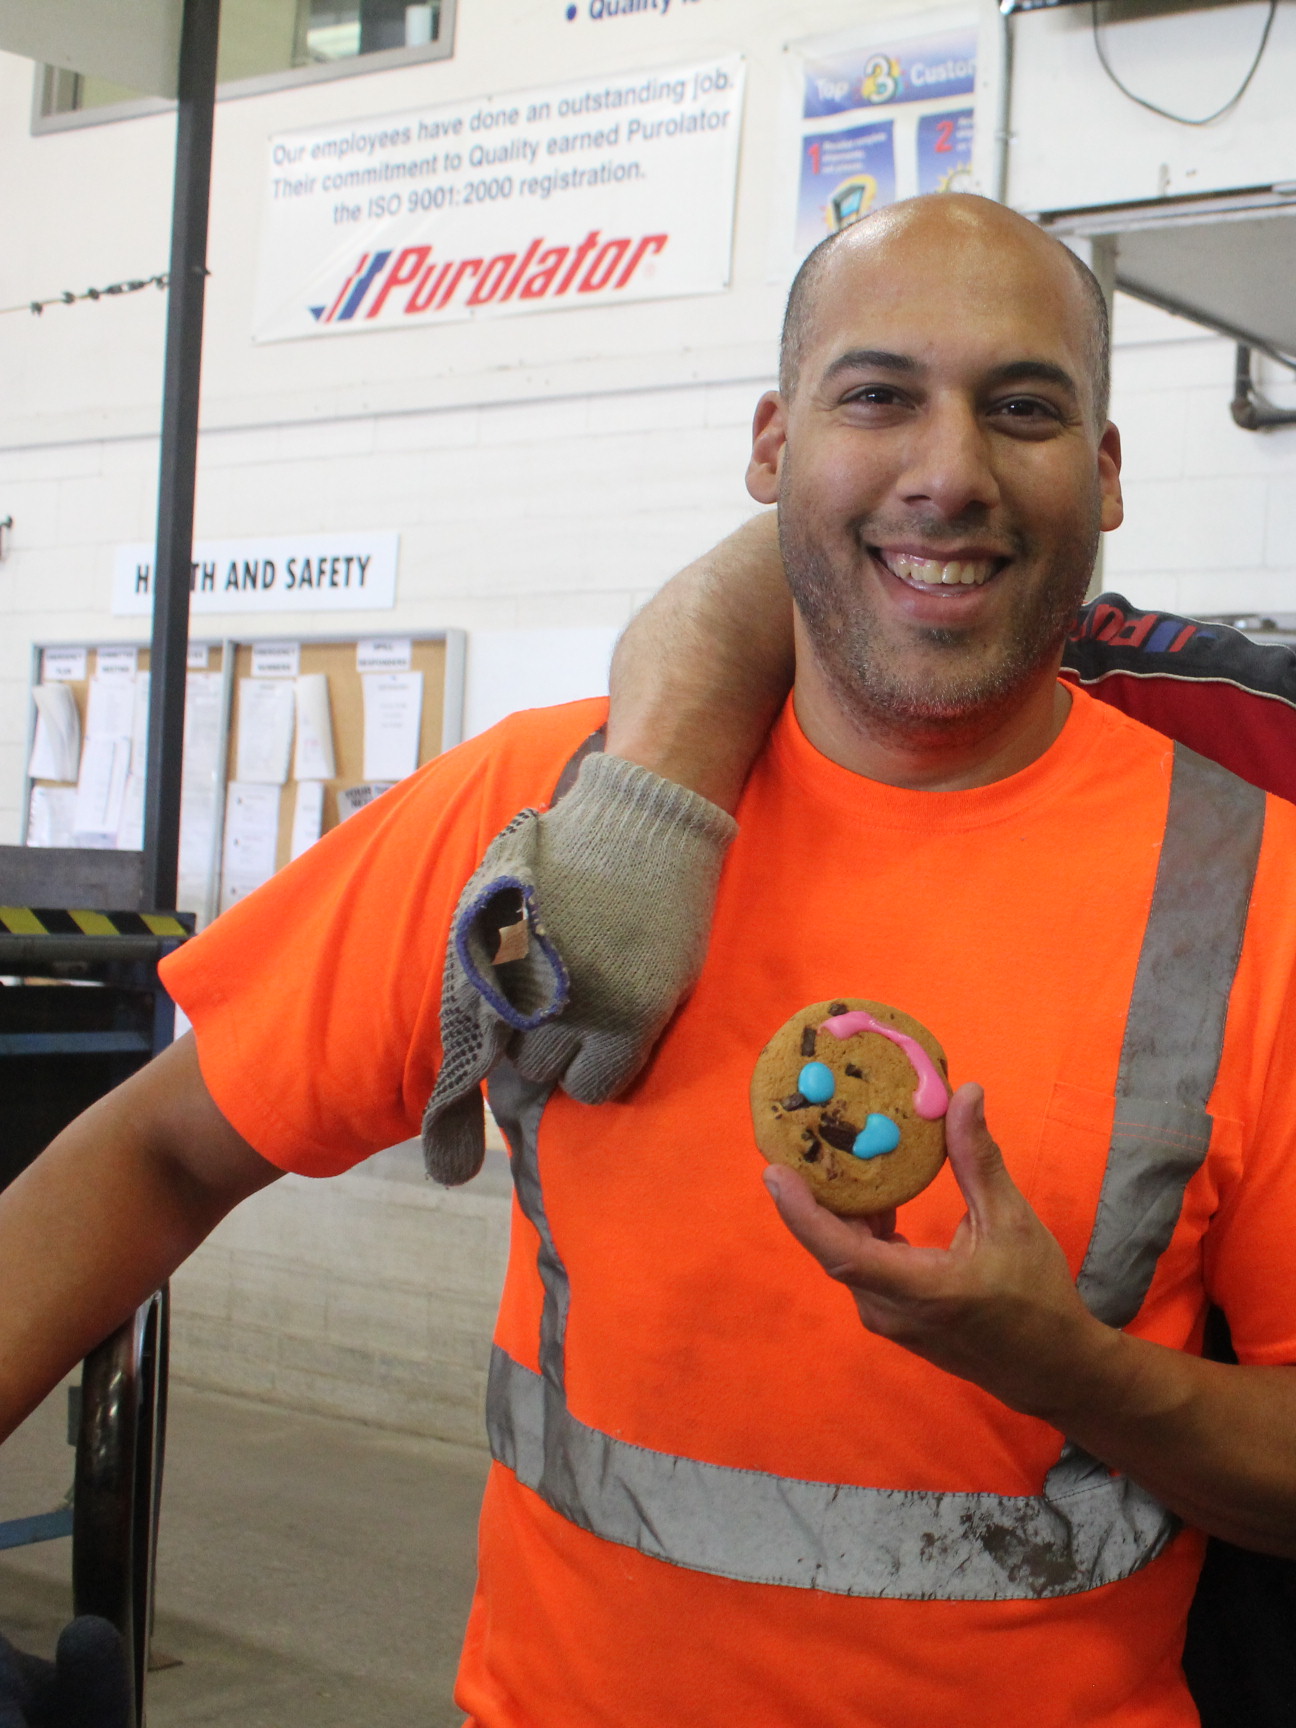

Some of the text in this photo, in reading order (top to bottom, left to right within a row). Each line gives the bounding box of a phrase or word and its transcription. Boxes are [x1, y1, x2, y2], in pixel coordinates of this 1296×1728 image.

[814, 78, 850, 102] Top
[864, 54, 898, 104] 3
[272, 67, 735, 166] Our employees have done an outstanding job.
[934, 120, 955, 153] 2
[272, 109, 731, 199] Their commitment to Quality earned Purolator
[808, 143, 820, 175] 1
[333, 160, 647, 225] the ISO 9001:2000 registration.
[364, 230, 669, 320] Purolator
[135, 554, 371, 594] HTH AND SAFETY
